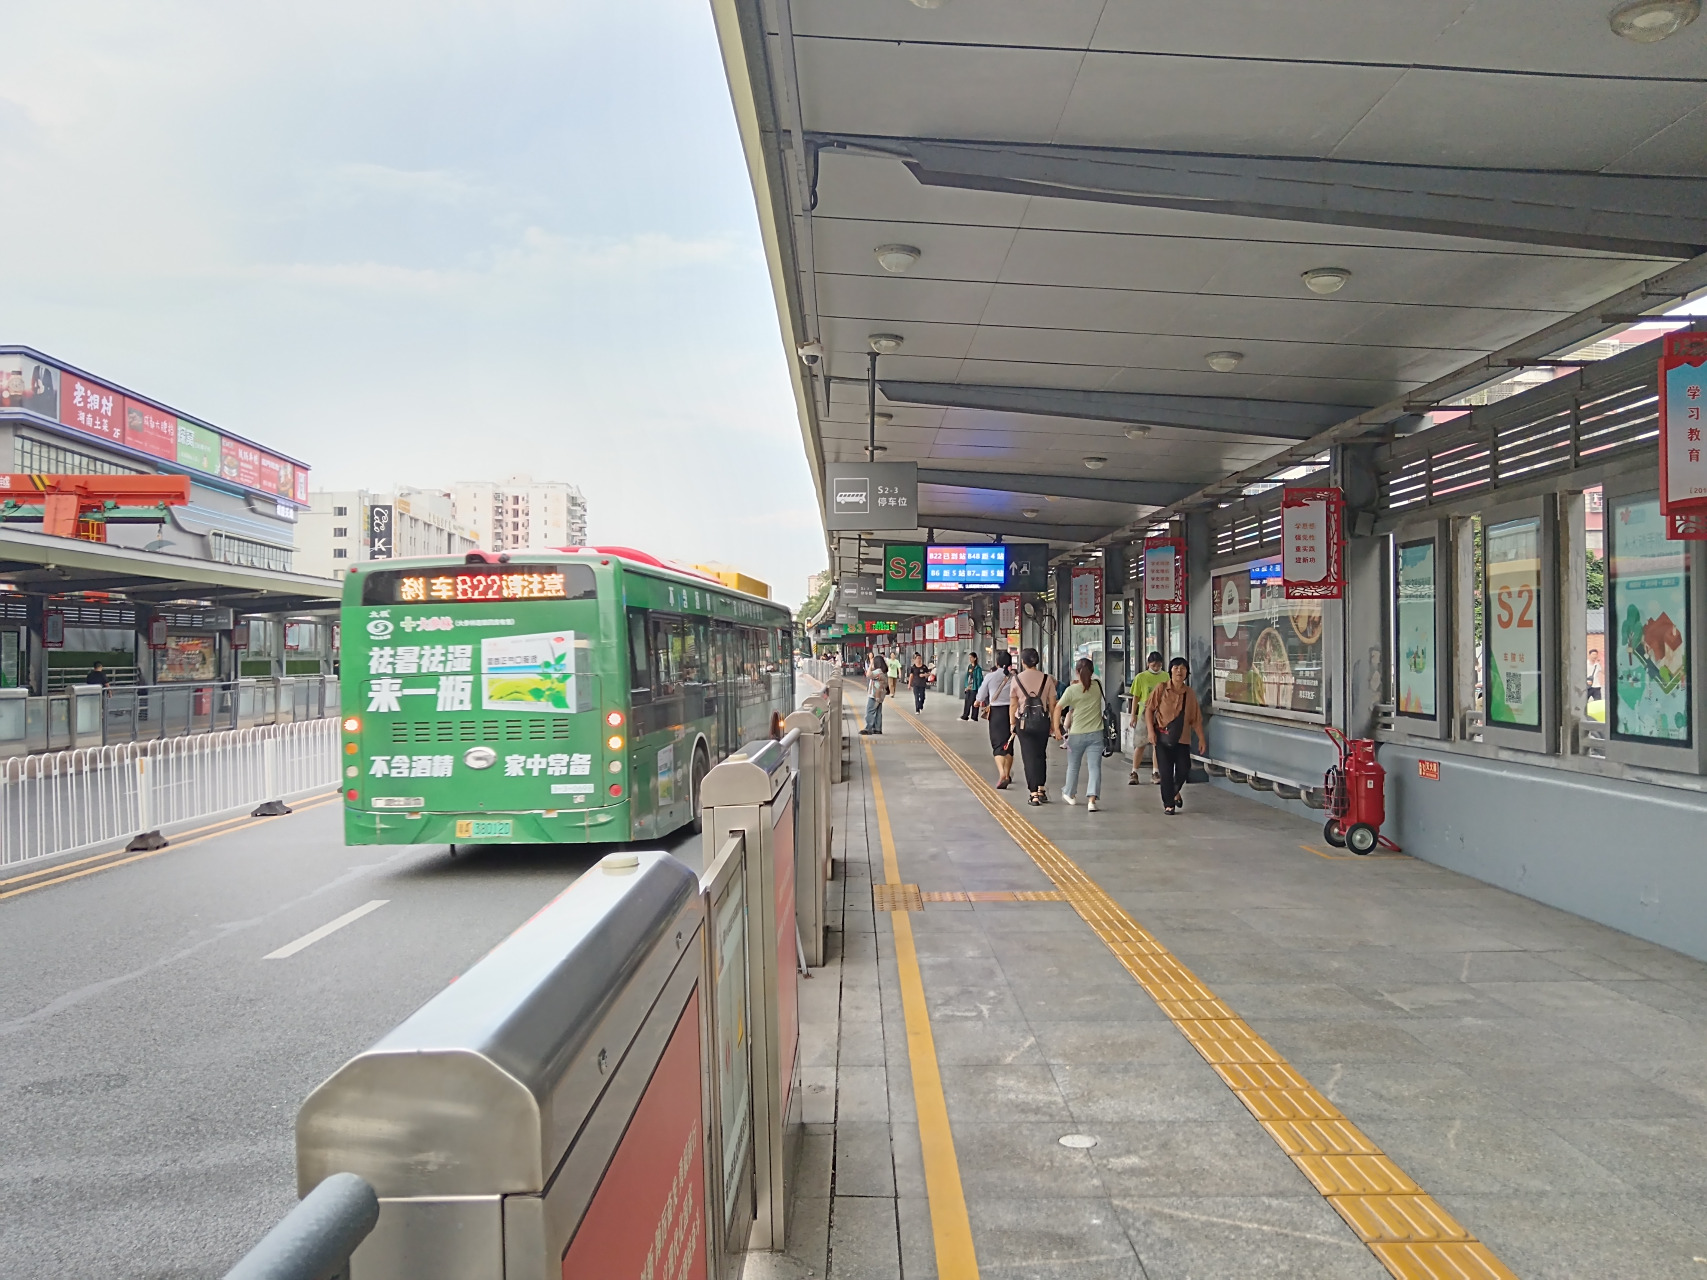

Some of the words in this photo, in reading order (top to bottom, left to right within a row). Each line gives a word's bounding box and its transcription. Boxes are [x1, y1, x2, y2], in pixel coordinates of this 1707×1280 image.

[1686, 385, 1702, 463] 学习教育
[877, 486, 899, 494] S2-3
[877, 496, 908, 507] 停车位
[889, 557, 922, 580] S2
[455, 575, 501, 600] B22
[502, 573, 566, 598] 请注意
[1497, 584, 1534, 629] S2
[368, 645, 473, 675] 祛暑祛湿
[366, 675, 474, 713] 来一瓶
[368, 755, 454, 778] 不含酒精
[504, 753, 592, 777] 家中常备
